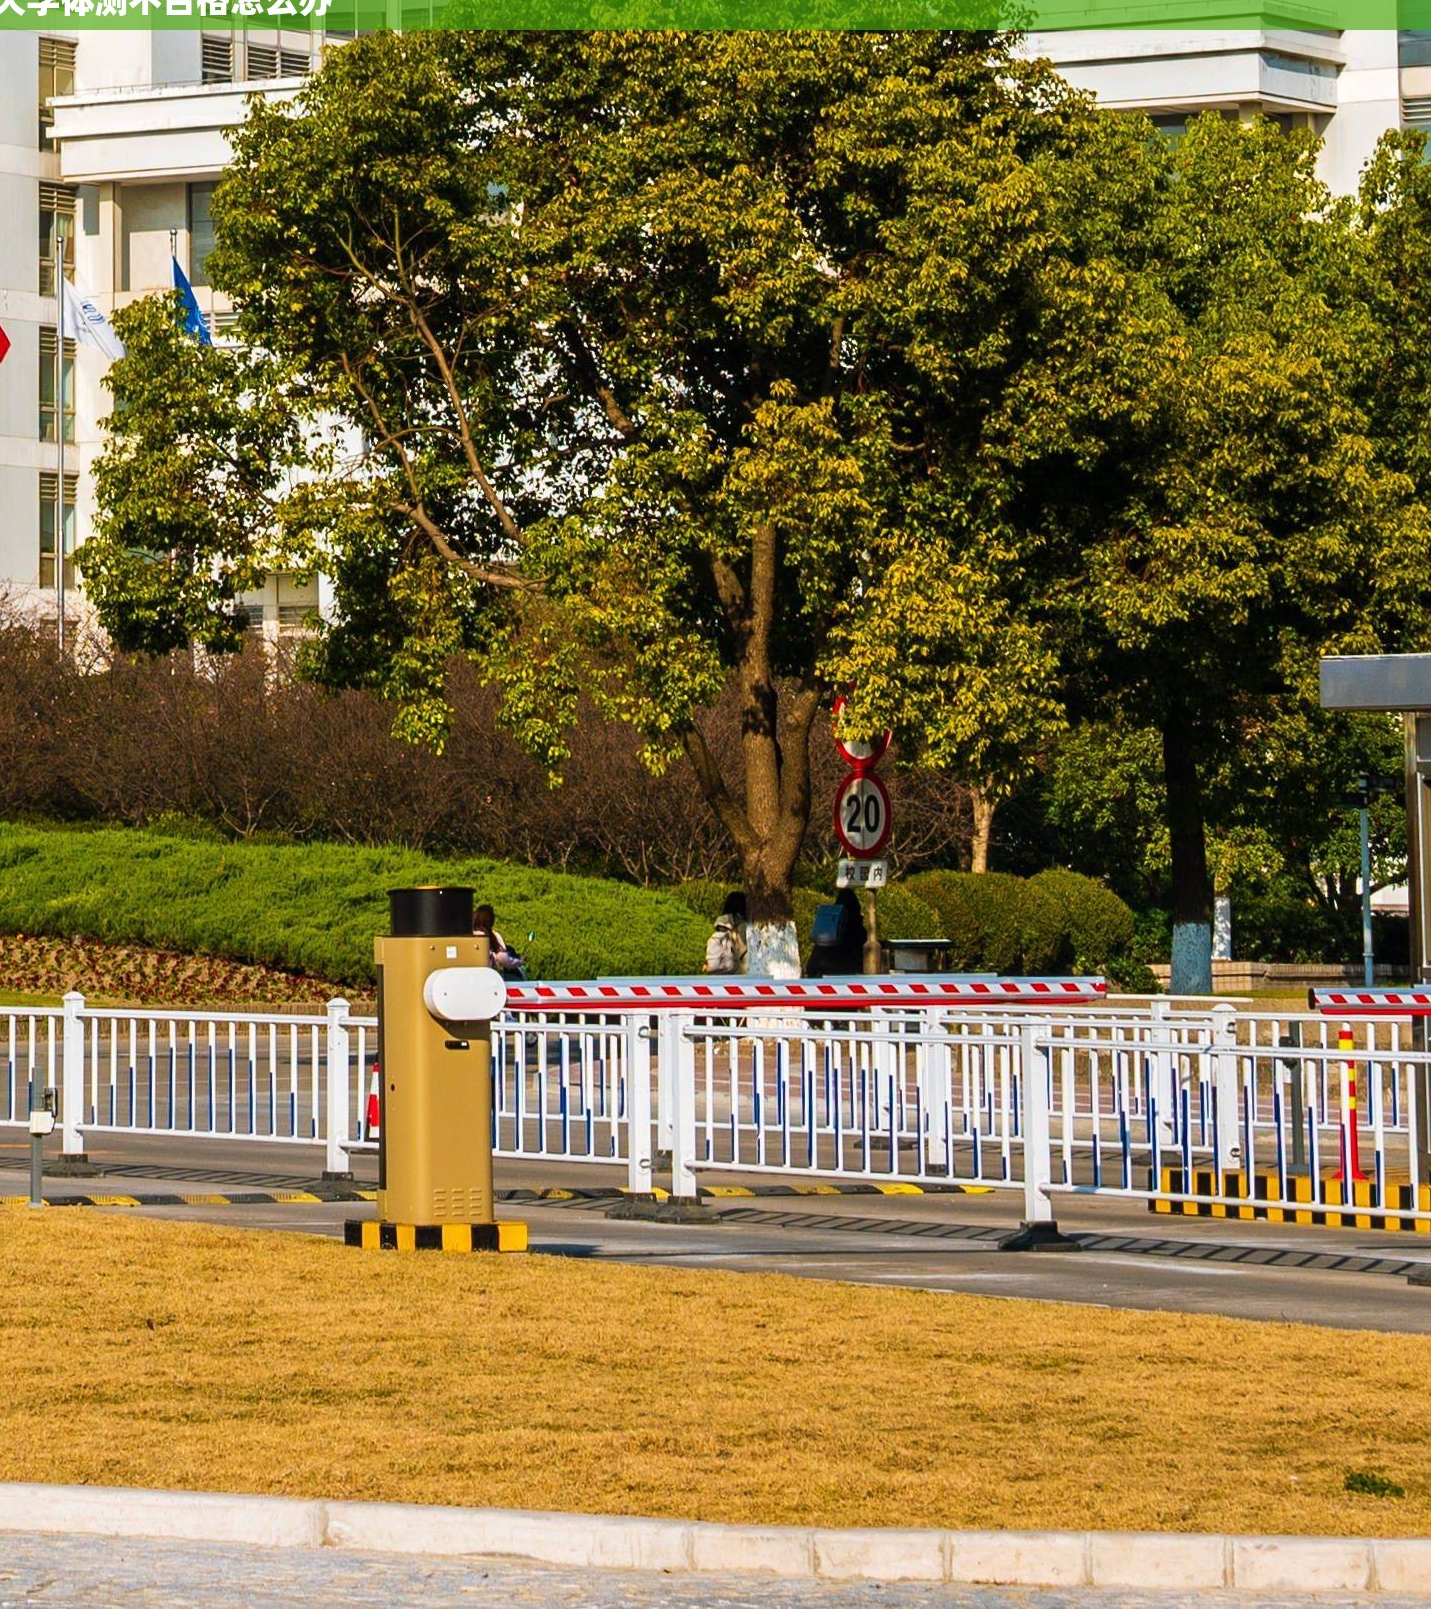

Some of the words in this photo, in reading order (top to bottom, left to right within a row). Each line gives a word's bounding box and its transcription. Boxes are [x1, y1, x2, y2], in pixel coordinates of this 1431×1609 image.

[846, 794, 881, 833] 20
[845, 865, 883, 882] 校园内
